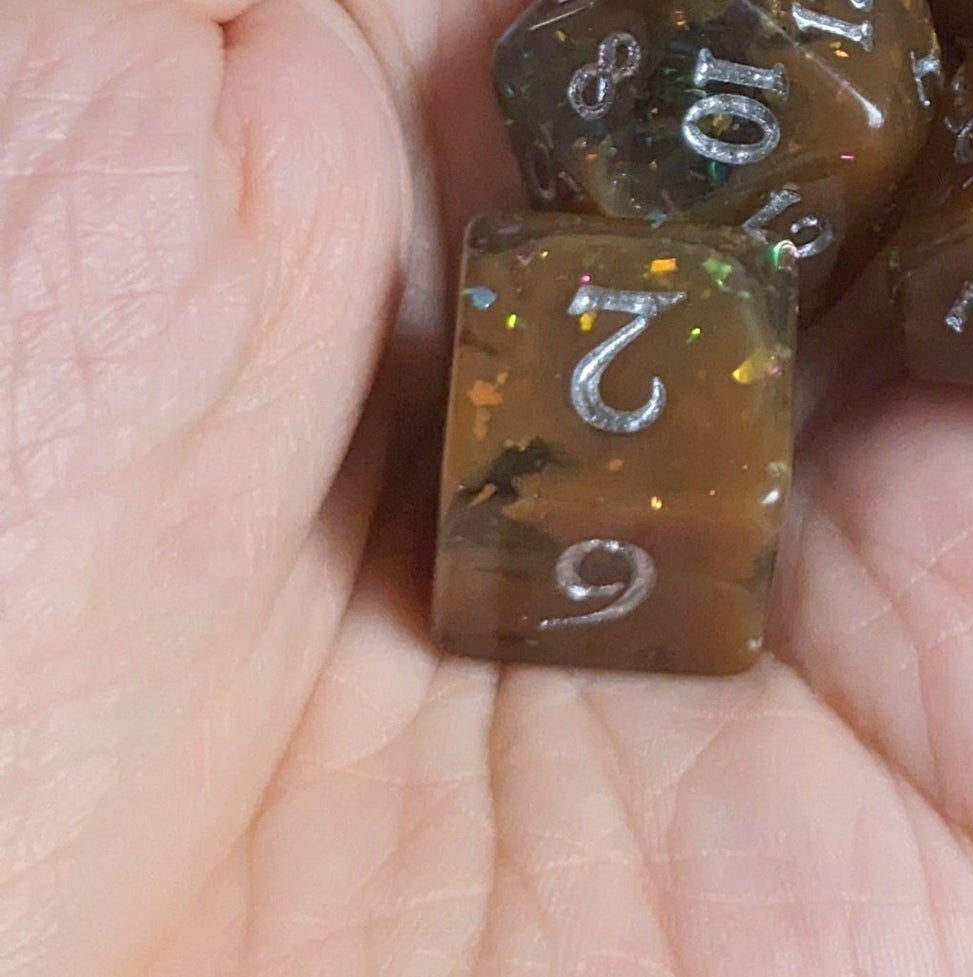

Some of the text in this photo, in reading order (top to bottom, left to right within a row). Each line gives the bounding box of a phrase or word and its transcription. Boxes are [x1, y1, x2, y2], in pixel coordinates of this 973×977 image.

[567, 31, 642, 120] 8
[682, 47, 789, 165] 10
[567, 284, 688, 434] 2
